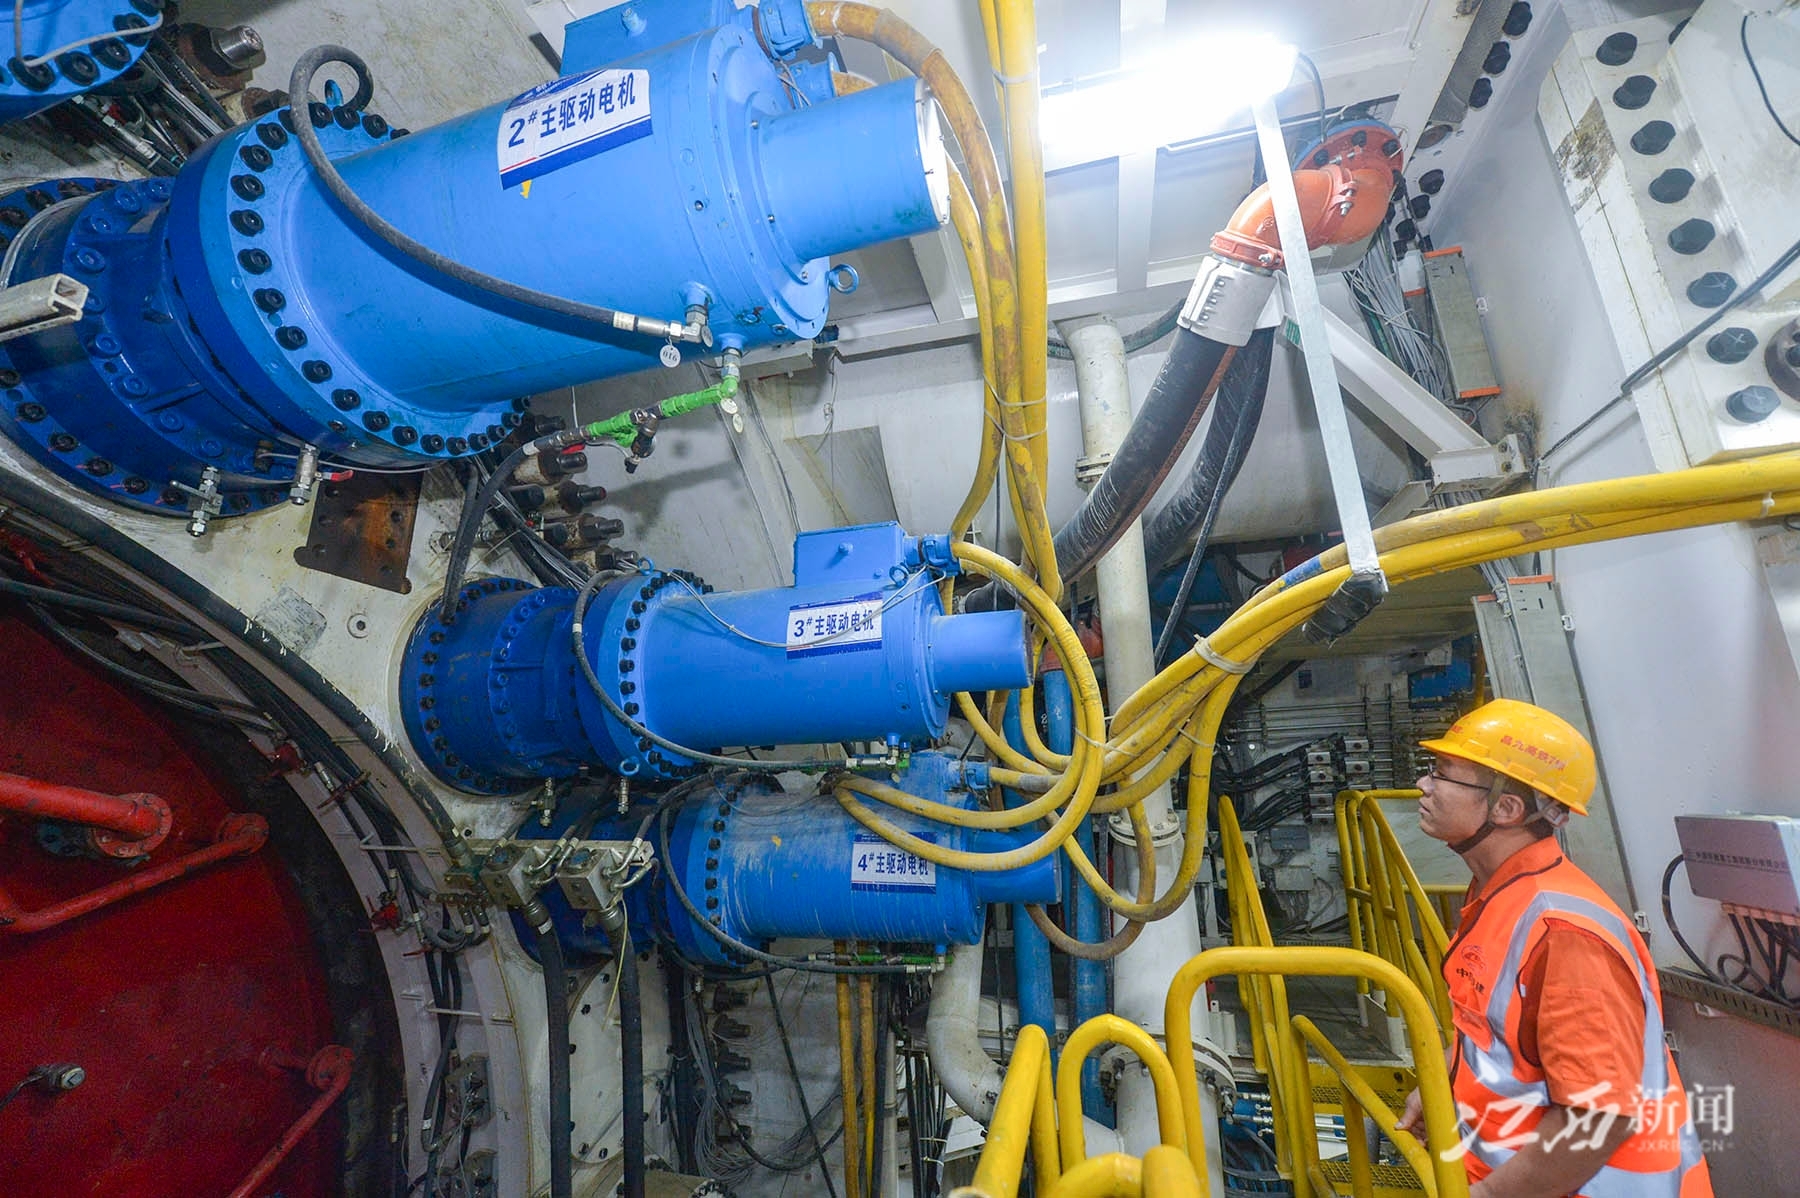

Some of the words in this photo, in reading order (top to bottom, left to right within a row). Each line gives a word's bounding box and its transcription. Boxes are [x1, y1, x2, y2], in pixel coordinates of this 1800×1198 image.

[508, 71, 636, 148] 2#主驱动电机
[794, 609, 874, 637] 3#主驱动电机
[858, 851, 928, 876] 4#主驱动电机
